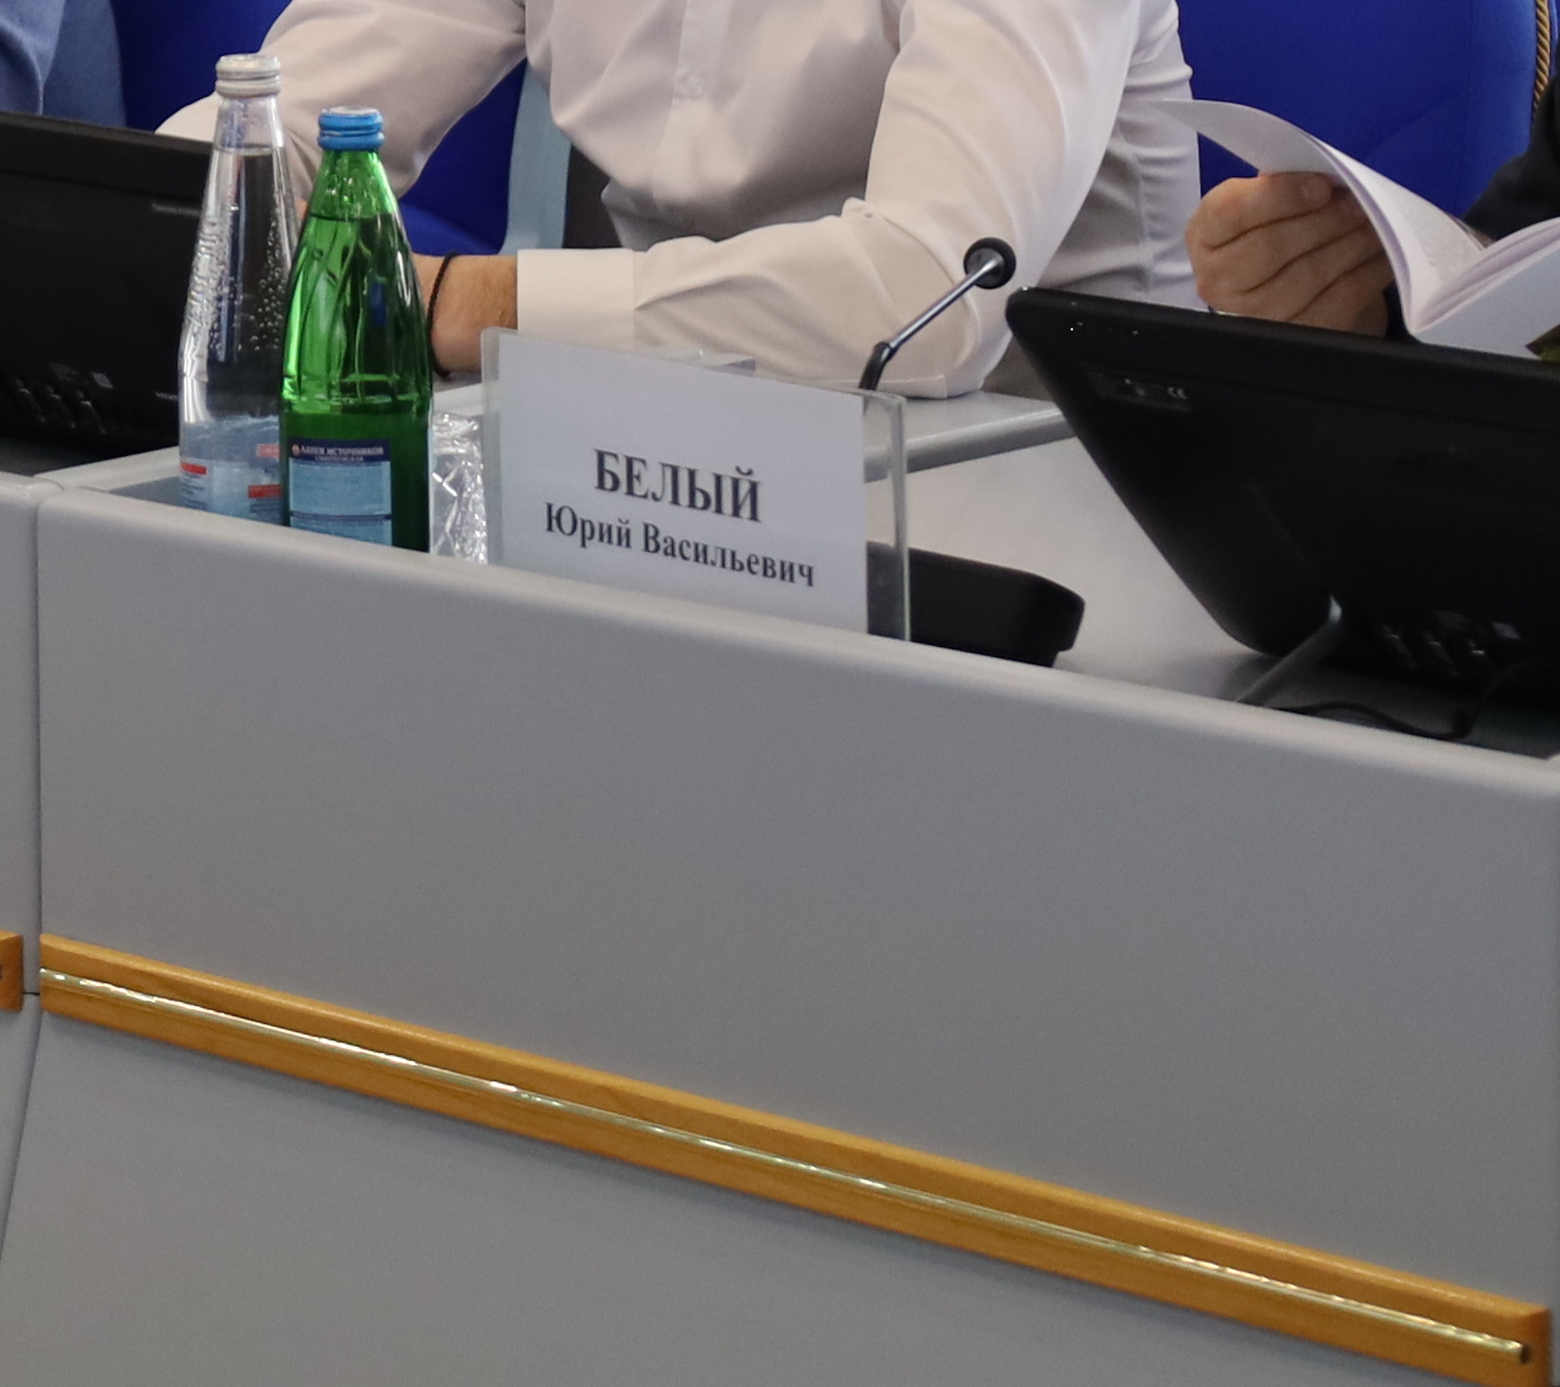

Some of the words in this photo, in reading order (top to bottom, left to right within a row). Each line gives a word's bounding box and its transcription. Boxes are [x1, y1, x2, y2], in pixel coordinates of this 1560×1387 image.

[594, 448, 761, 523] БЕЛЫЙ
[545, 502, 632, 549] Юрий
[641, 521, 815, 587] Васильевич
